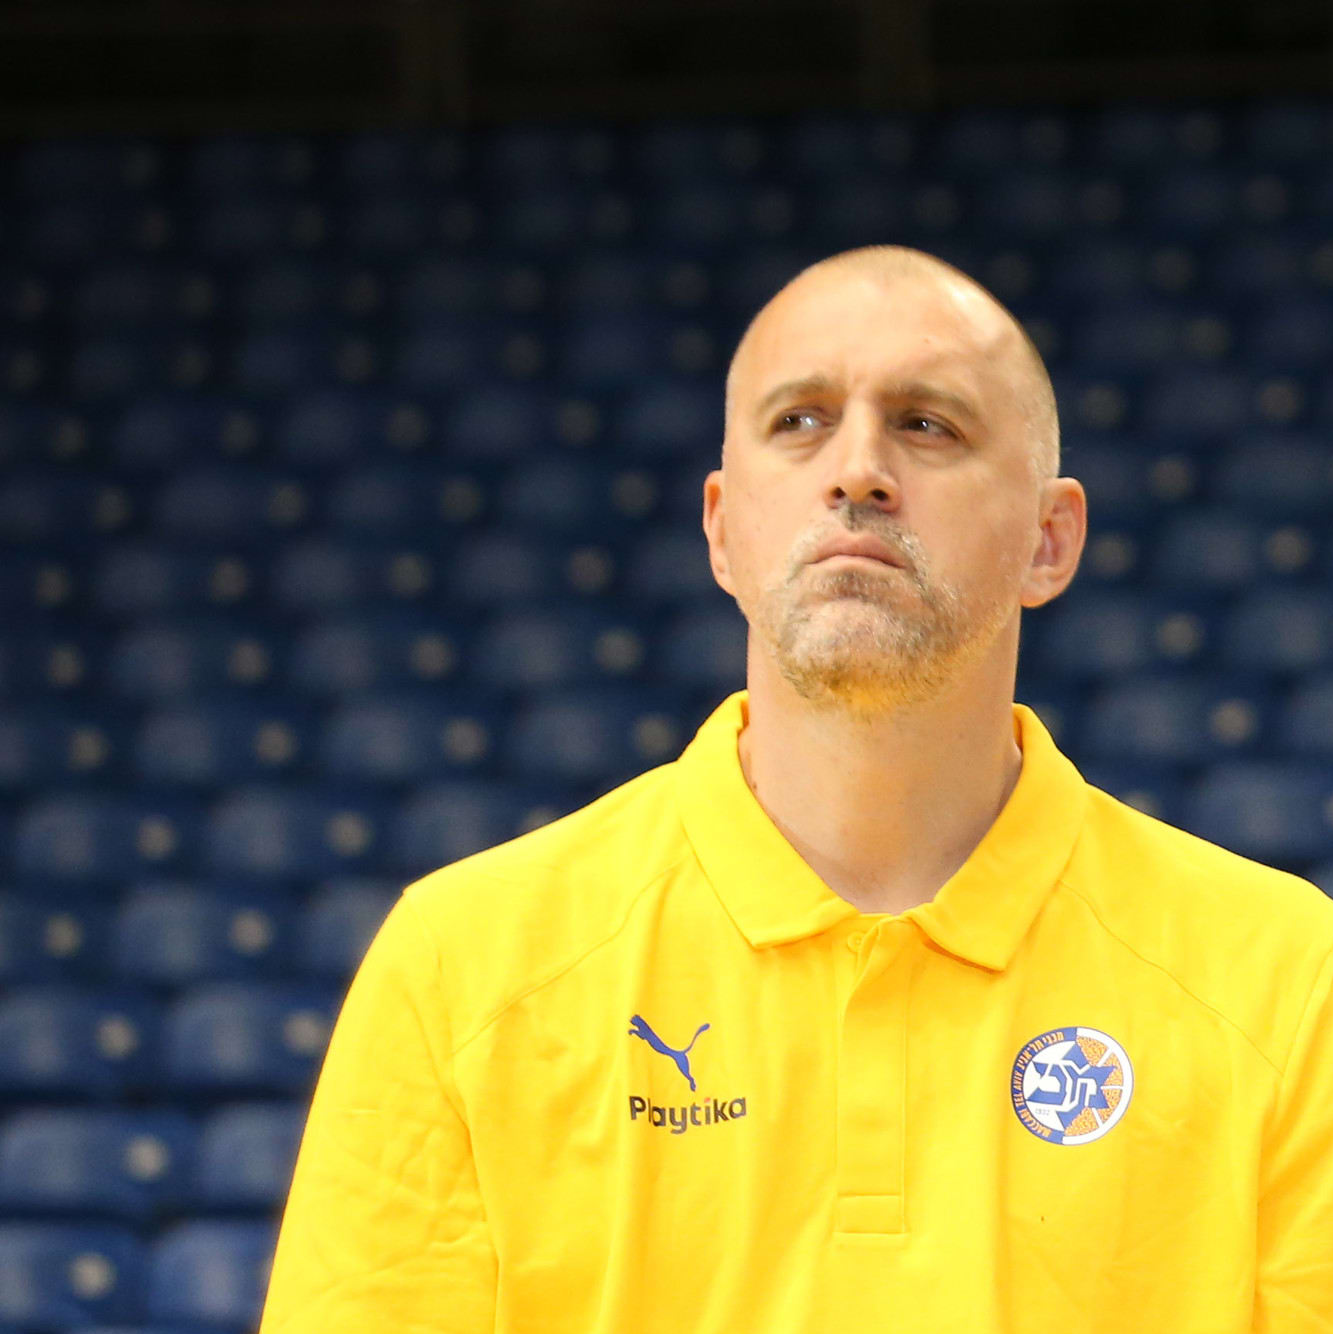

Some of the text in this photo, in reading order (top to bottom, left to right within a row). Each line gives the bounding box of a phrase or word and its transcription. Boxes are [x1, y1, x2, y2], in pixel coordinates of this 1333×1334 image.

[629, 1095, 746, 1135] Playtika
[1012, 1071, 1052, 1137] MACCABI TEL AVIV
